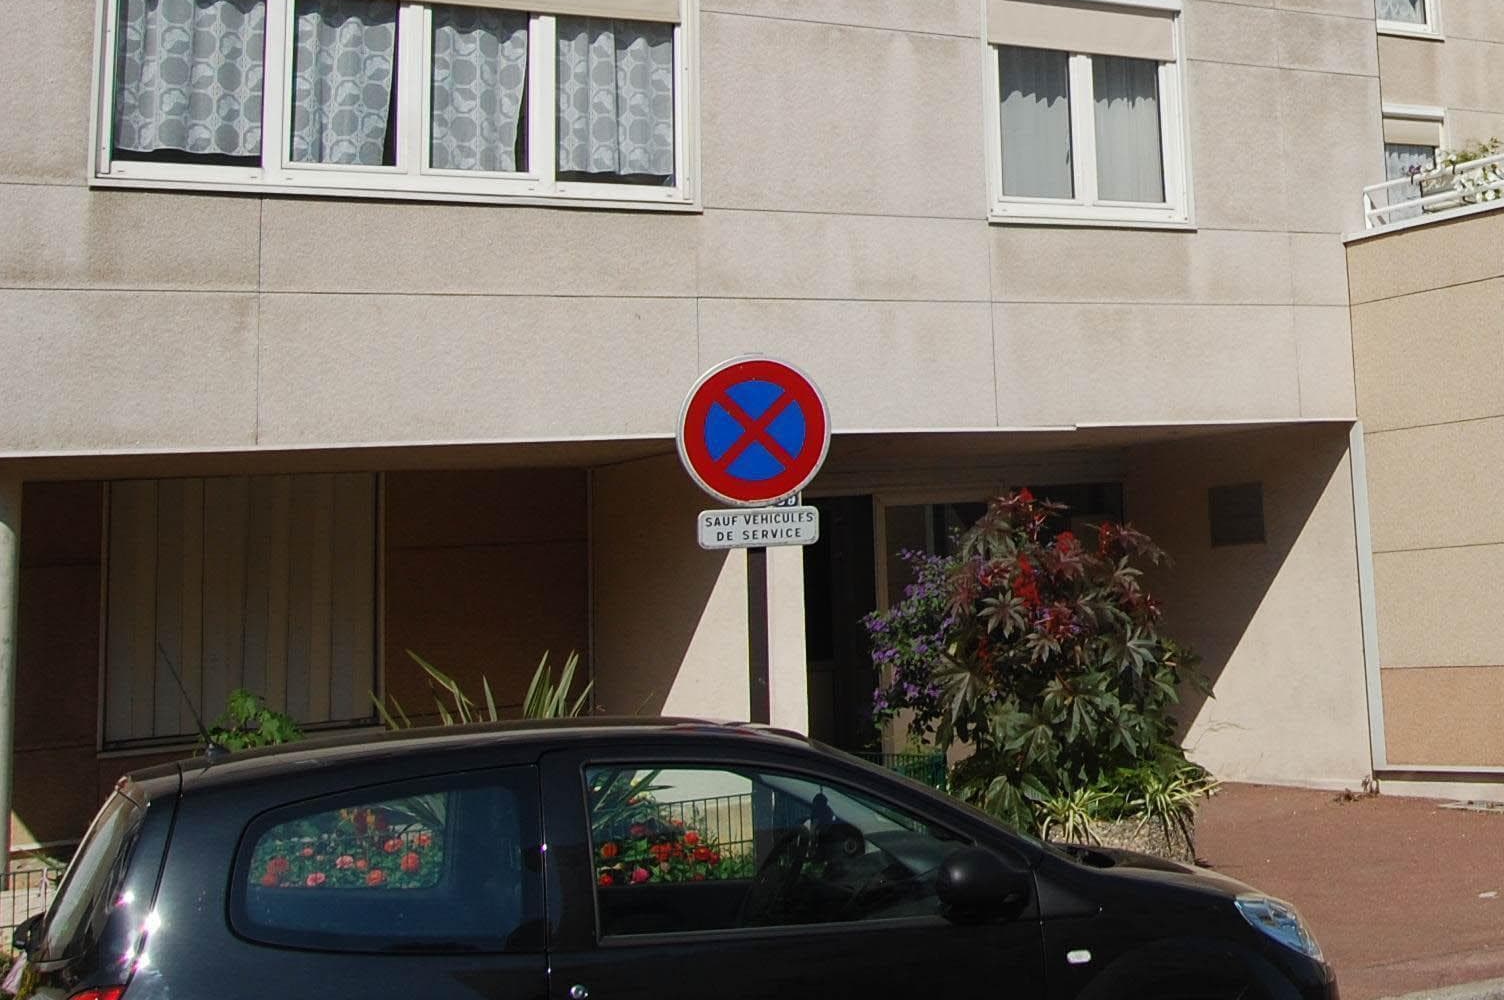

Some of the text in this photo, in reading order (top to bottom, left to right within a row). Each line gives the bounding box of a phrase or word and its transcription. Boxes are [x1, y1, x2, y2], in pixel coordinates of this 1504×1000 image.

[705, 512, 813, 527] SAUF VEHICULES
[716, 528, 801, 541] DE SERVICE
